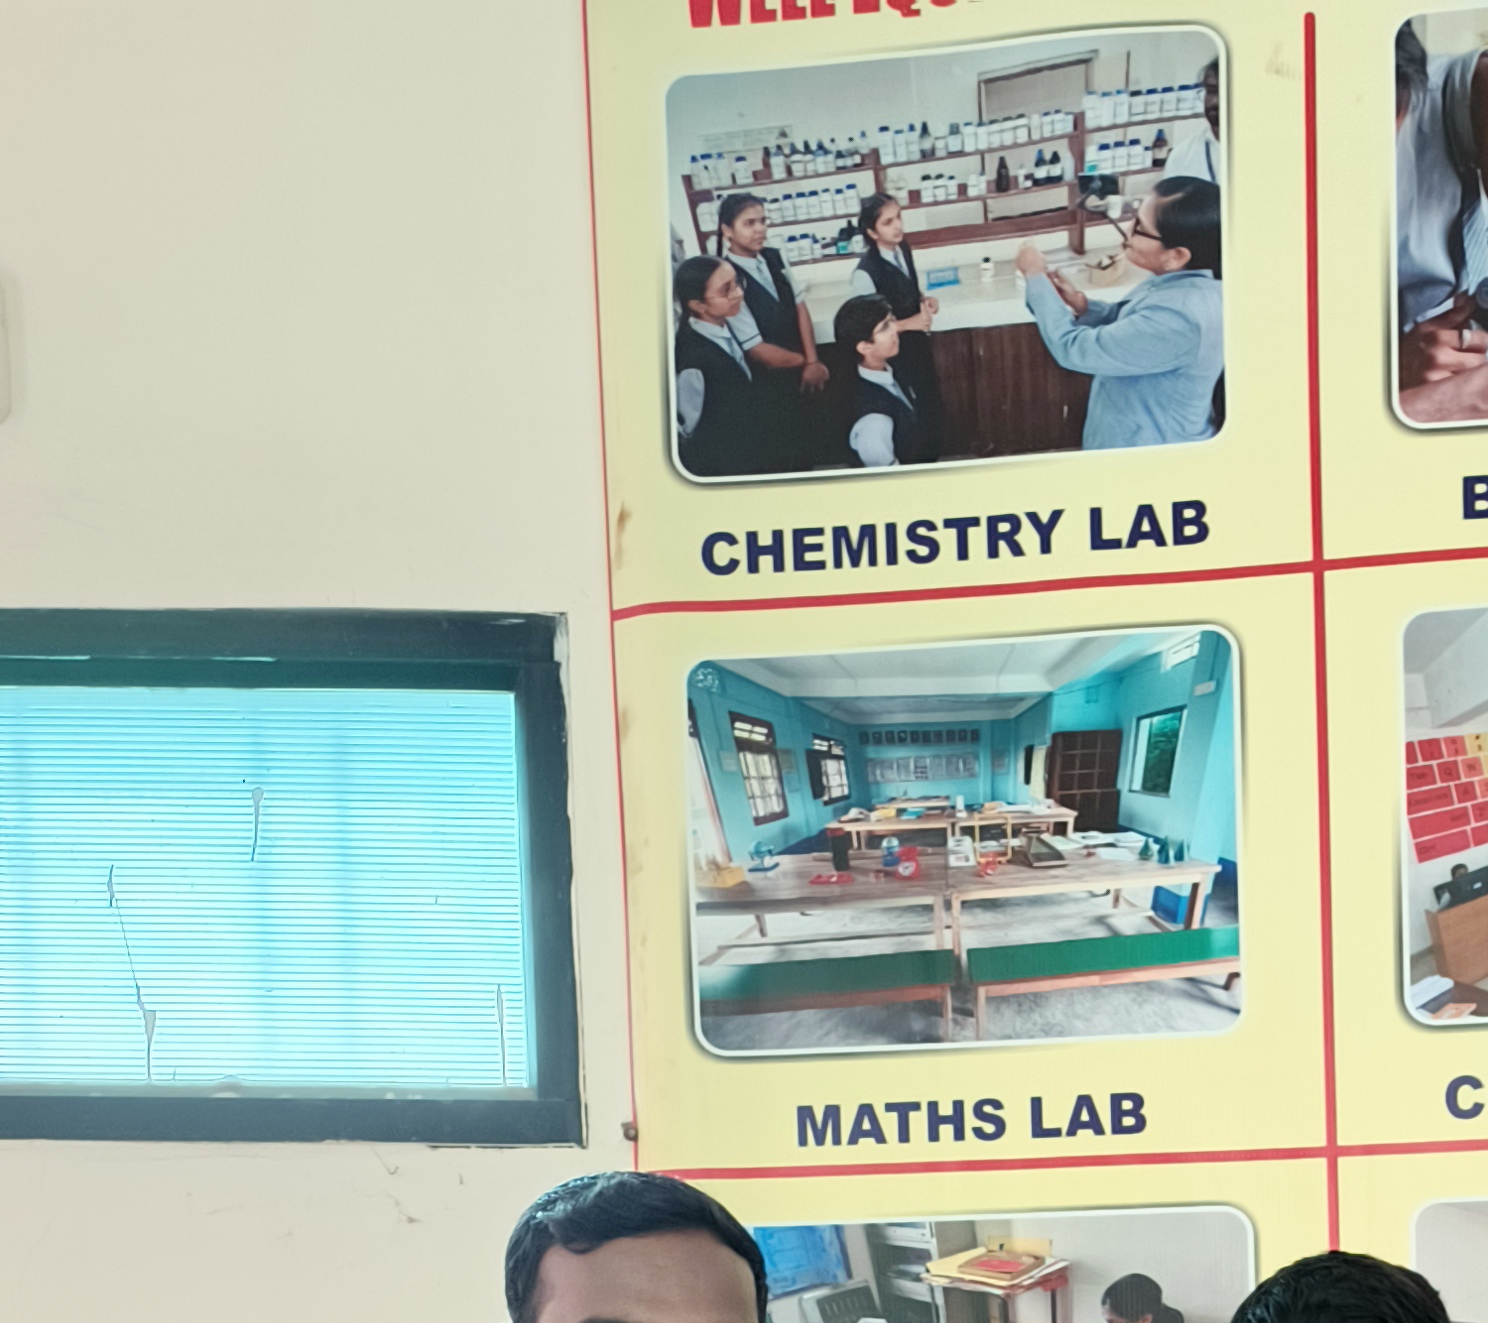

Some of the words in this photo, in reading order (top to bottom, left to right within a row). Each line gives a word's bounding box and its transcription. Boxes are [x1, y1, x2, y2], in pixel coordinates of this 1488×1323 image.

[701, 510, 1063, 575] CHEMISTRY
[1090, 500, 1208, 550] LAB
[797, 1099, 1005, 1147] MATHS
[1031, 1093, 1145, 1138] LAB
